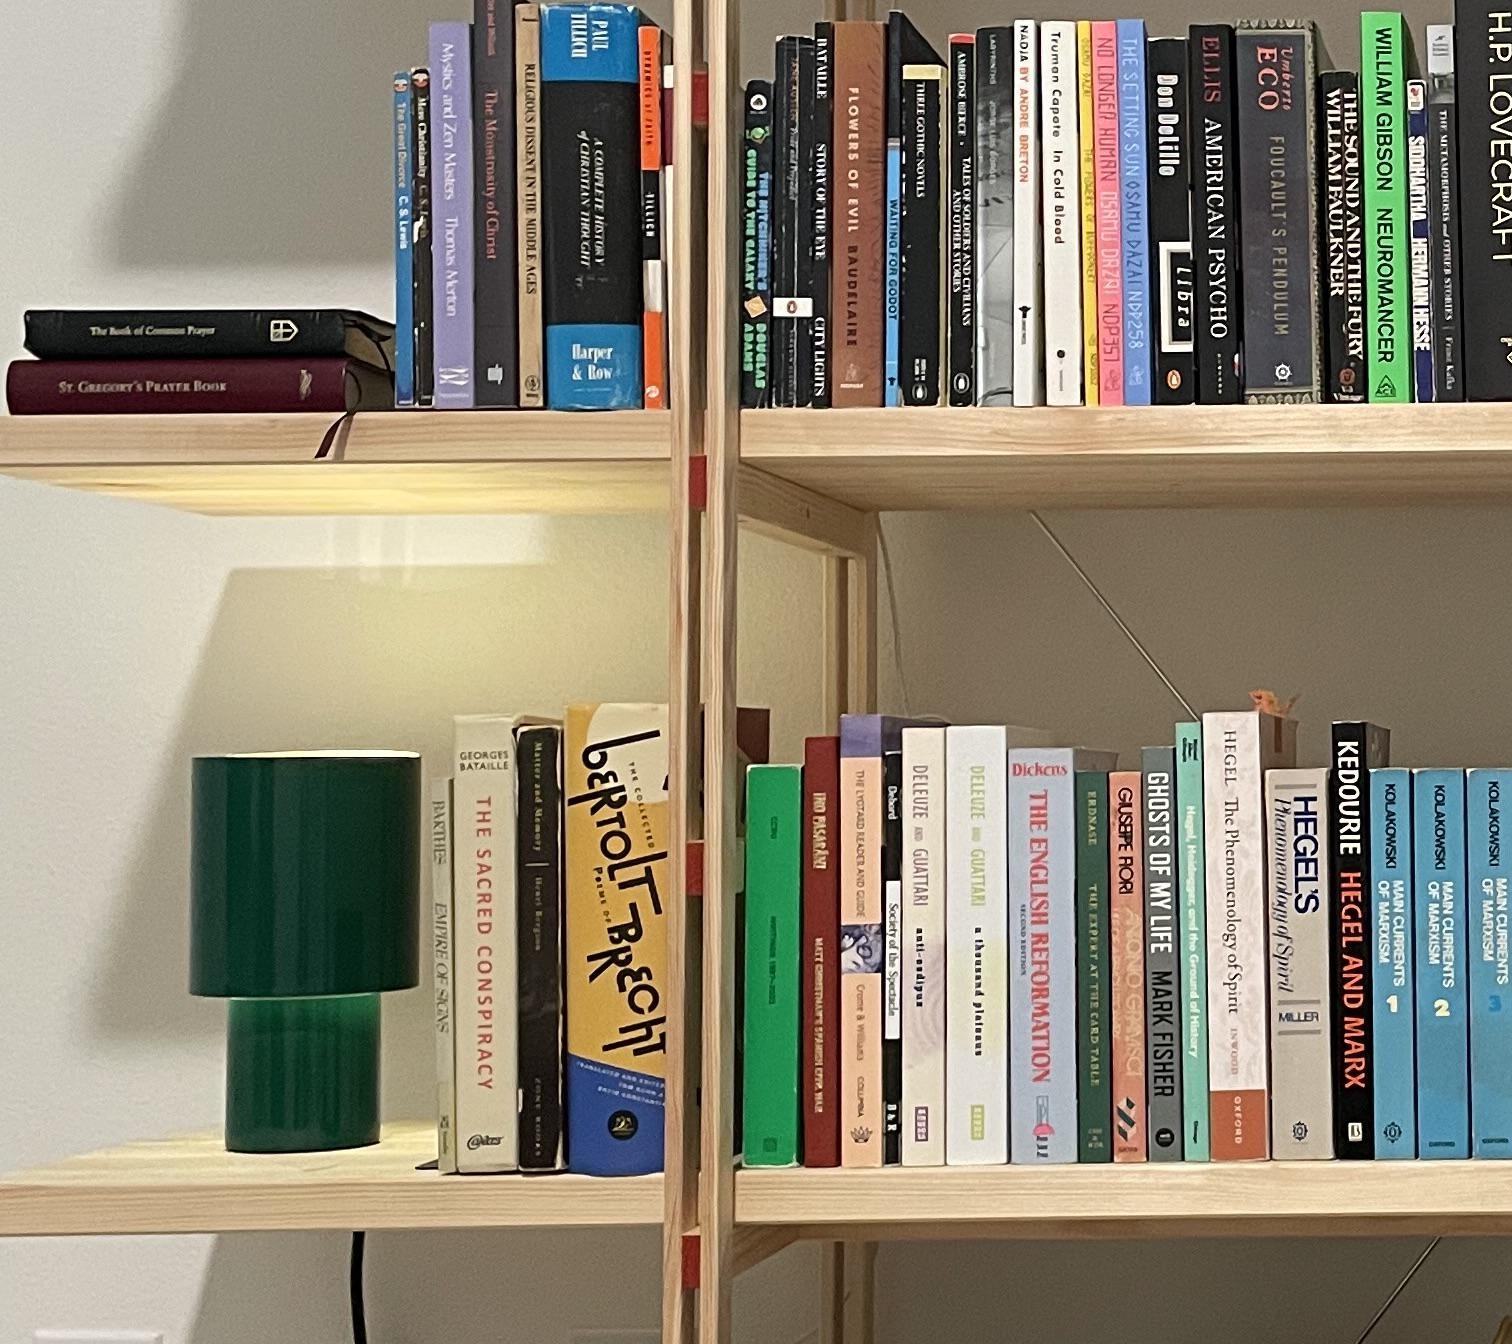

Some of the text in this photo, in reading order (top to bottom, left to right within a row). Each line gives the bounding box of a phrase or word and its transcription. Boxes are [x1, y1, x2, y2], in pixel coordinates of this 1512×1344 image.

[571, 14, 587, 57] TILLICH
[592, 20, 608, 50] PAUL
[1050, 32, 1064, 244] Truman Capote In Cold Blood
[1257, 46, 1278, 111] ECO
[1280, 46, 1293, 111] Umberto
[1488, 12, 1510, 63] H.P.
[524, 64, 537, 295] RELIGIOUS DISSENT IN THE MIDDLE AGES
[846, 88, 859, 346] FLOWERS OF EVIL BAUDELAIRE
[1202, 37, 1227, 338] ELLIS AMERICAN PSYCHO
[1270, 137, 1289, 335] FOUCAULT'S PENDULUM
[1325, 88, 1345, 296] WILLIAM FAULKNER
[1344, 88, 1363, 360] THE SOUND AND THE FURY
[1376, 28, 1394, 363] WILLIAM GIBSON NEUROMANCER
[1337, 741, 1365, 1088] KEDOURIE HEGEL AND MARX
[1378, 880, 1390, 963] OF MARXISM
[1385, 784, 1397, 869] KOLAKOWSKI
[476, 797, 493, 1090] THE SACRED CONSPIRACY
[1147, 772, 1174, 1097] GHOSTS OF MY LIFE MARK FISHER
[1222, 730, 1242, 1144] HEGEL The Phenomenology of Spirit OXFORD
[1387, 996, 1398, 1012] 1
[1392, 880, 1405, 986] MAIN CURRENTS
